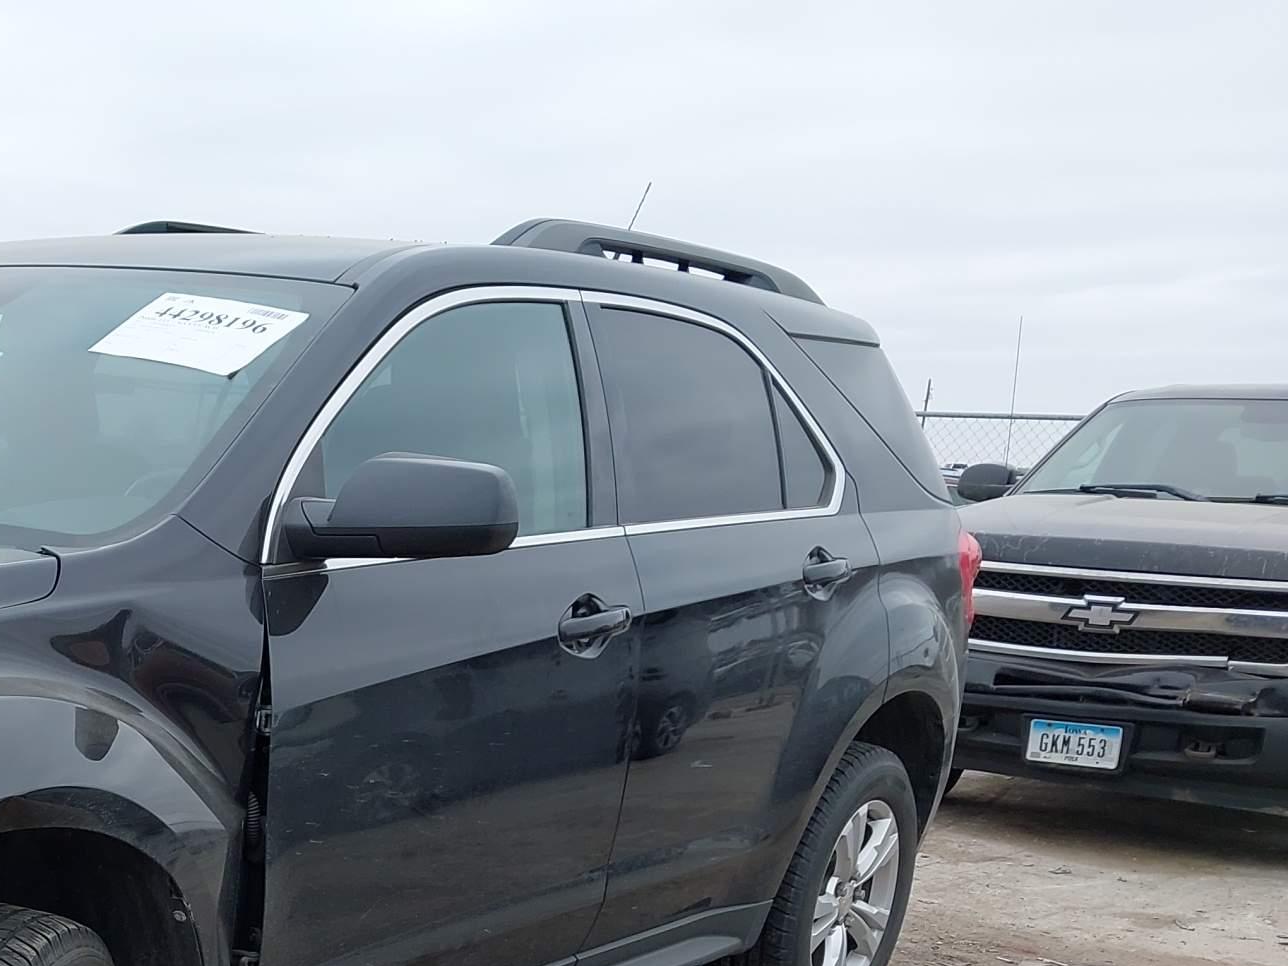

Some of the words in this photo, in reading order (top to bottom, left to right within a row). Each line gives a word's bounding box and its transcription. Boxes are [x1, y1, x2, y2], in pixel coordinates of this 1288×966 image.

[155, 306, 272, 334] 44298196
[1039, 733, 1071, 755] GKM
[1076, 737, 1107, 758] 553
